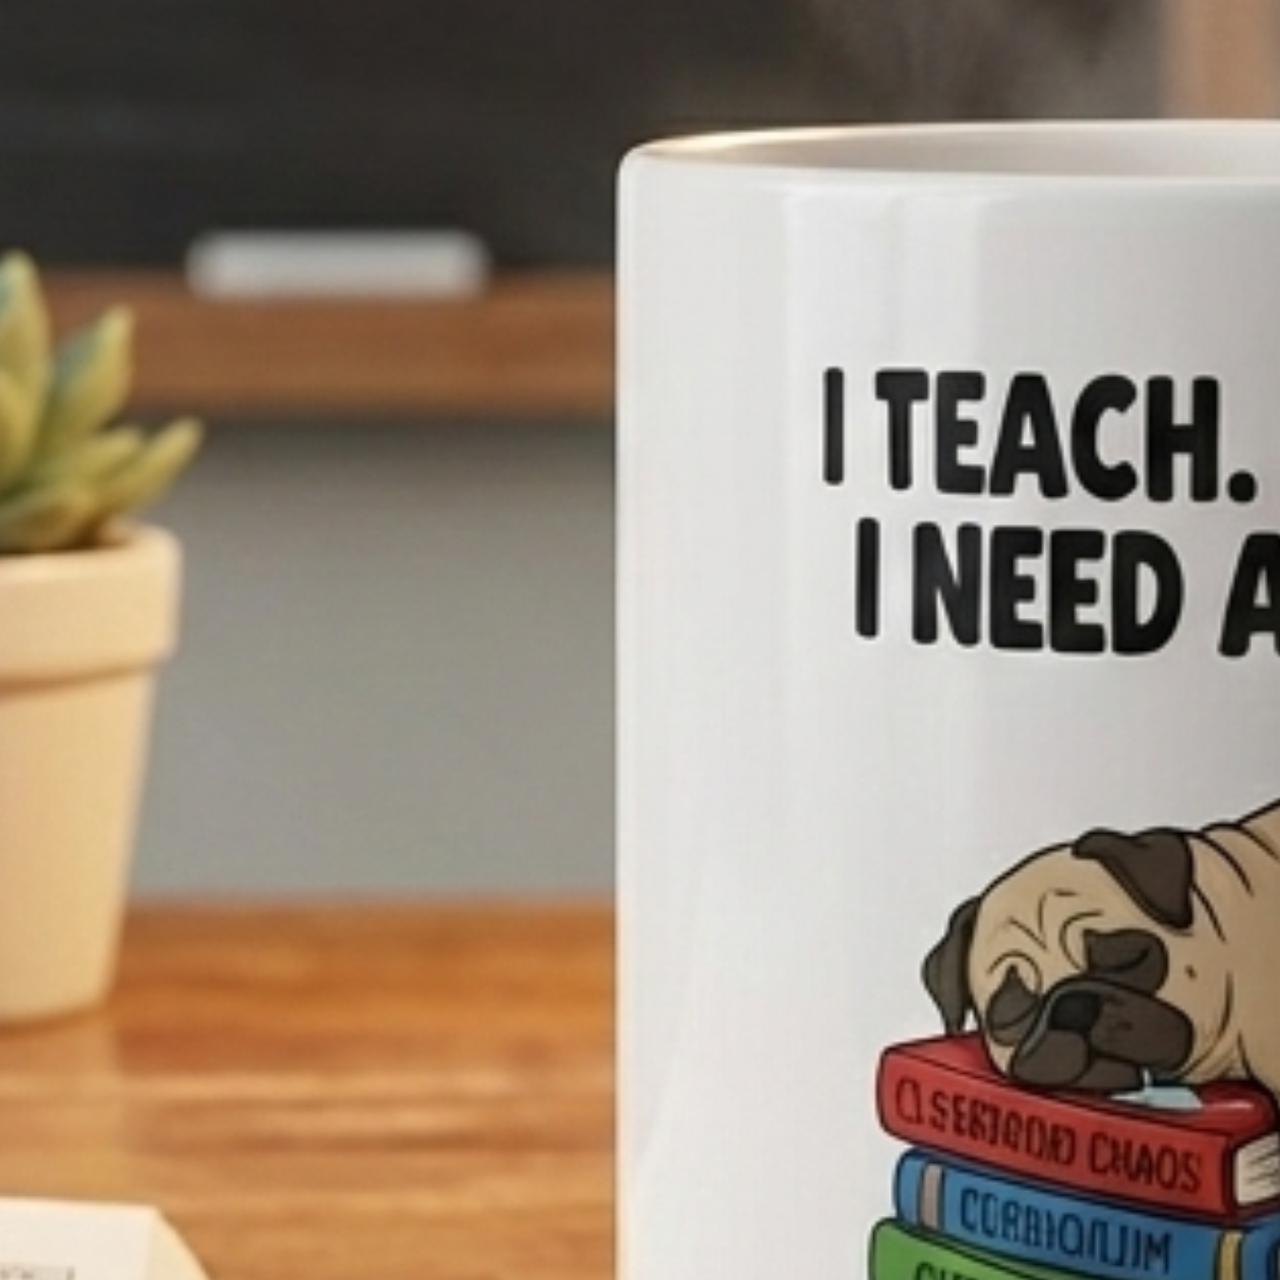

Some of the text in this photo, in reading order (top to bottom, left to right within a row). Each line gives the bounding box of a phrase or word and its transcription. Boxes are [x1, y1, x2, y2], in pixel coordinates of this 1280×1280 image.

[822, 367, 846, 486] I
[875, 368, 1258, 504] TEACH.
[854, 516, 881, 639] I
[910, 520, 1185, 656] NEED
